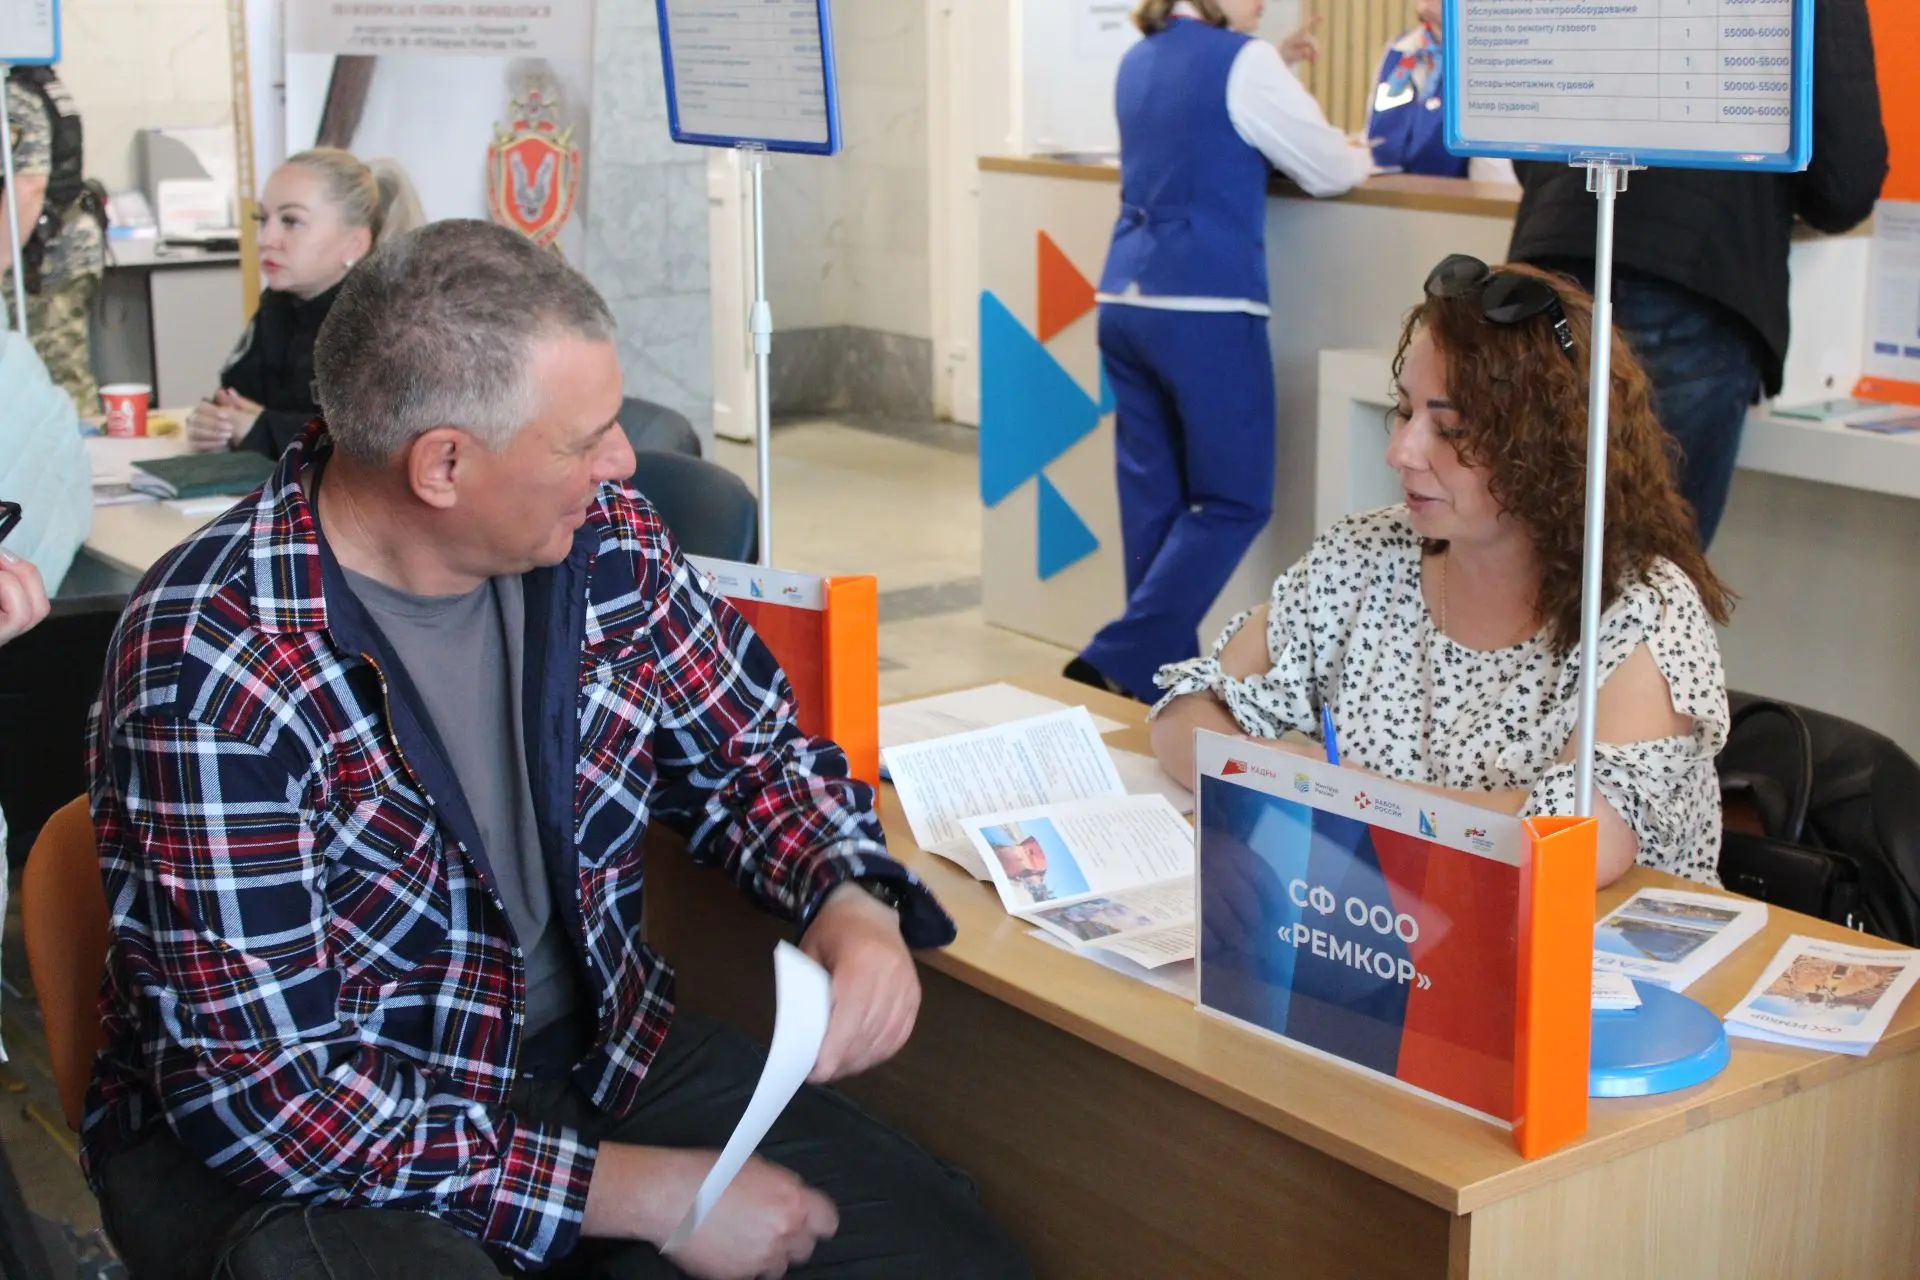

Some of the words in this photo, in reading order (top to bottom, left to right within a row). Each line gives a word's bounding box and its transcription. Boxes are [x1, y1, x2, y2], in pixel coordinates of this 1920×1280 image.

[1535, 5, 1638, 16] электрооборудования
[1467, 24, 1502, 34] Слесарь
[1505, 25, 1515, 33] по
[1517, 25, 1554, 34] ремонту
[1556, 24, 1597, 33] газового
[1685, 28, 1691, 38] 1
[1724, 28, 1790, 38] 55000-60000
[1467, 36, 1529, 47] оборудования
[1467, 56, 1553, 67] Слесарь-ремонтник
[1685, 56, 1691, 67] 1
[1724, 56, 1790, 67] 50000-55000
[1467, 78, 1554, 89] Слесарь-монтажник
[1557, 79, 1595, 91] судовой
[1685, 81, 1691, 90] 1
[1723, 81, 1789, 91] 50000-55000
[1468, 101, 1496, 111] Маляр
[1498, 101, 1540, 112] (судовой)
[1685, 105, 1691, 115] 1
[1722, 106, 1790, 116] 60000-60000
[1374, 798, 1401, 811] РАБОТА
[1374, 805, 1402, 818] РОССИИ
[1288, 878, 1336, 916] СФ
[1344, 897, 1420, 944] ООО
[1277, 922, 1433, 991] «РЕМКОР»
